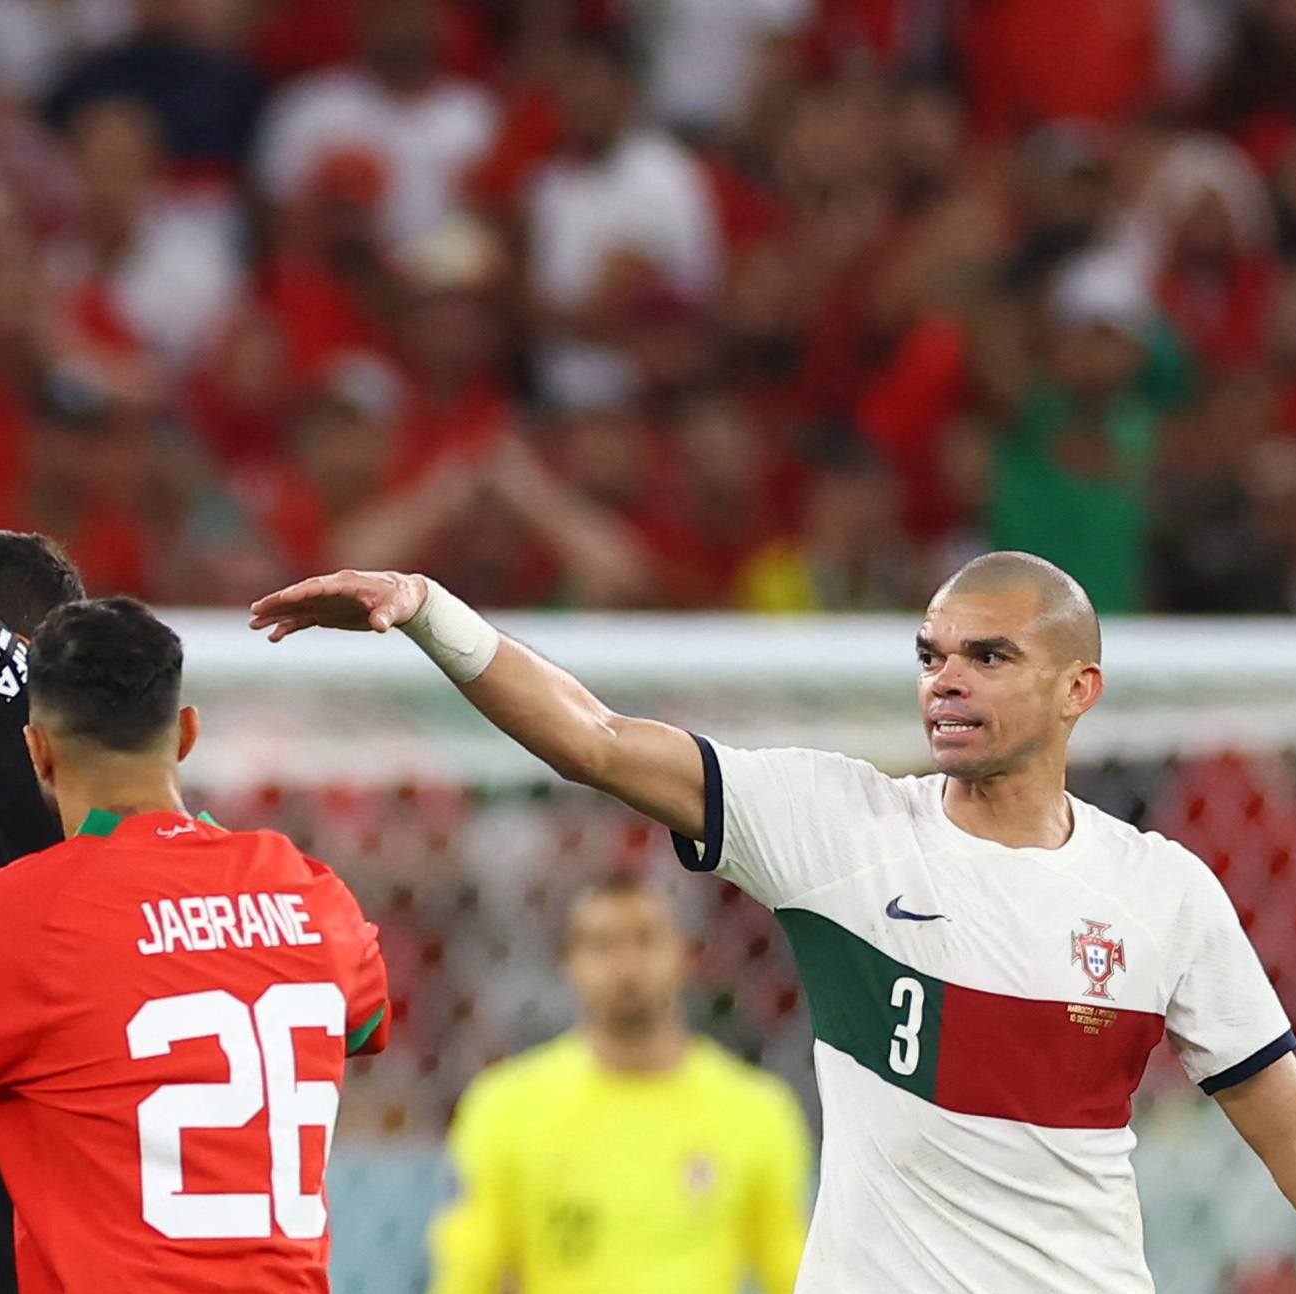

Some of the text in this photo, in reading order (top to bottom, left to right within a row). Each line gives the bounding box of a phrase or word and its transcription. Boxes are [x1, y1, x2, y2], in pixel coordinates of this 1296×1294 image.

[137, 893, 322, 955] JABRANE
[889, 976, 925, 1076] 3
[125, 981, 348, 1239] 26
